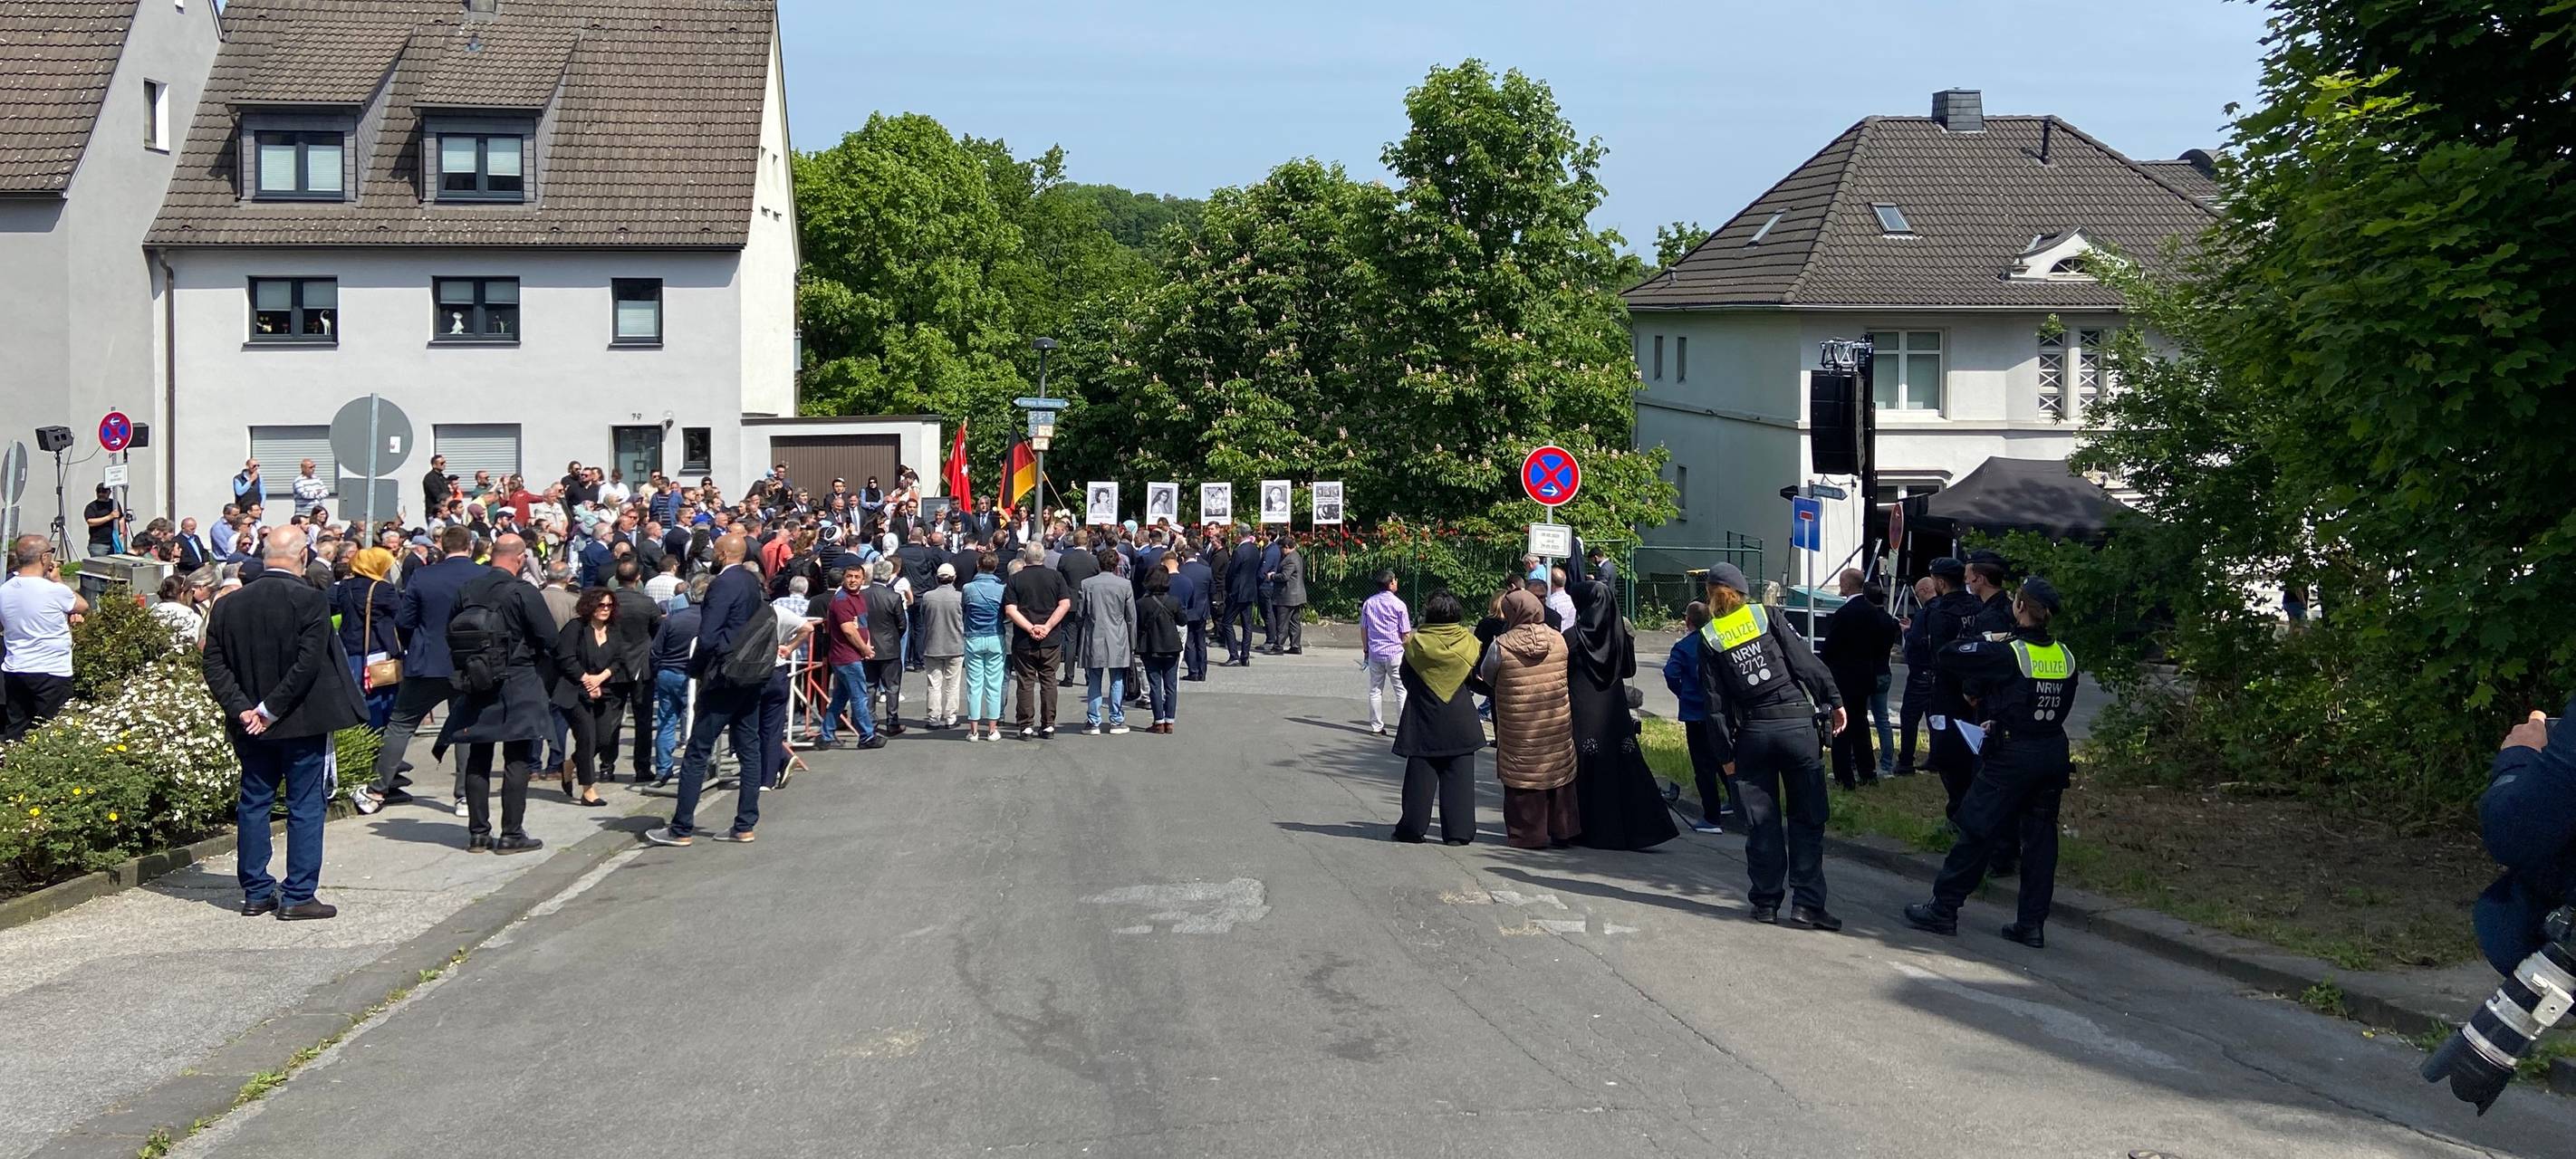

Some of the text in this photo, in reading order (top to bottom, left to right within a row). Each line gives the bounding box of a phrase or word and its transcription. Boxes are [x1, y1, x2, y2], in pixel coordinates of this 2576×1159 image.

[1720, 621, 1756, 643] POLIZEI
[1731, 641, 1762, 663] NRW
[1739, 656, 1767, 675] 2712
[2033, 660, 2067, 674] POLIZEI
[2036, 681, 2063, 694] NRW
[2037, 695, 2062, 708] 2713
